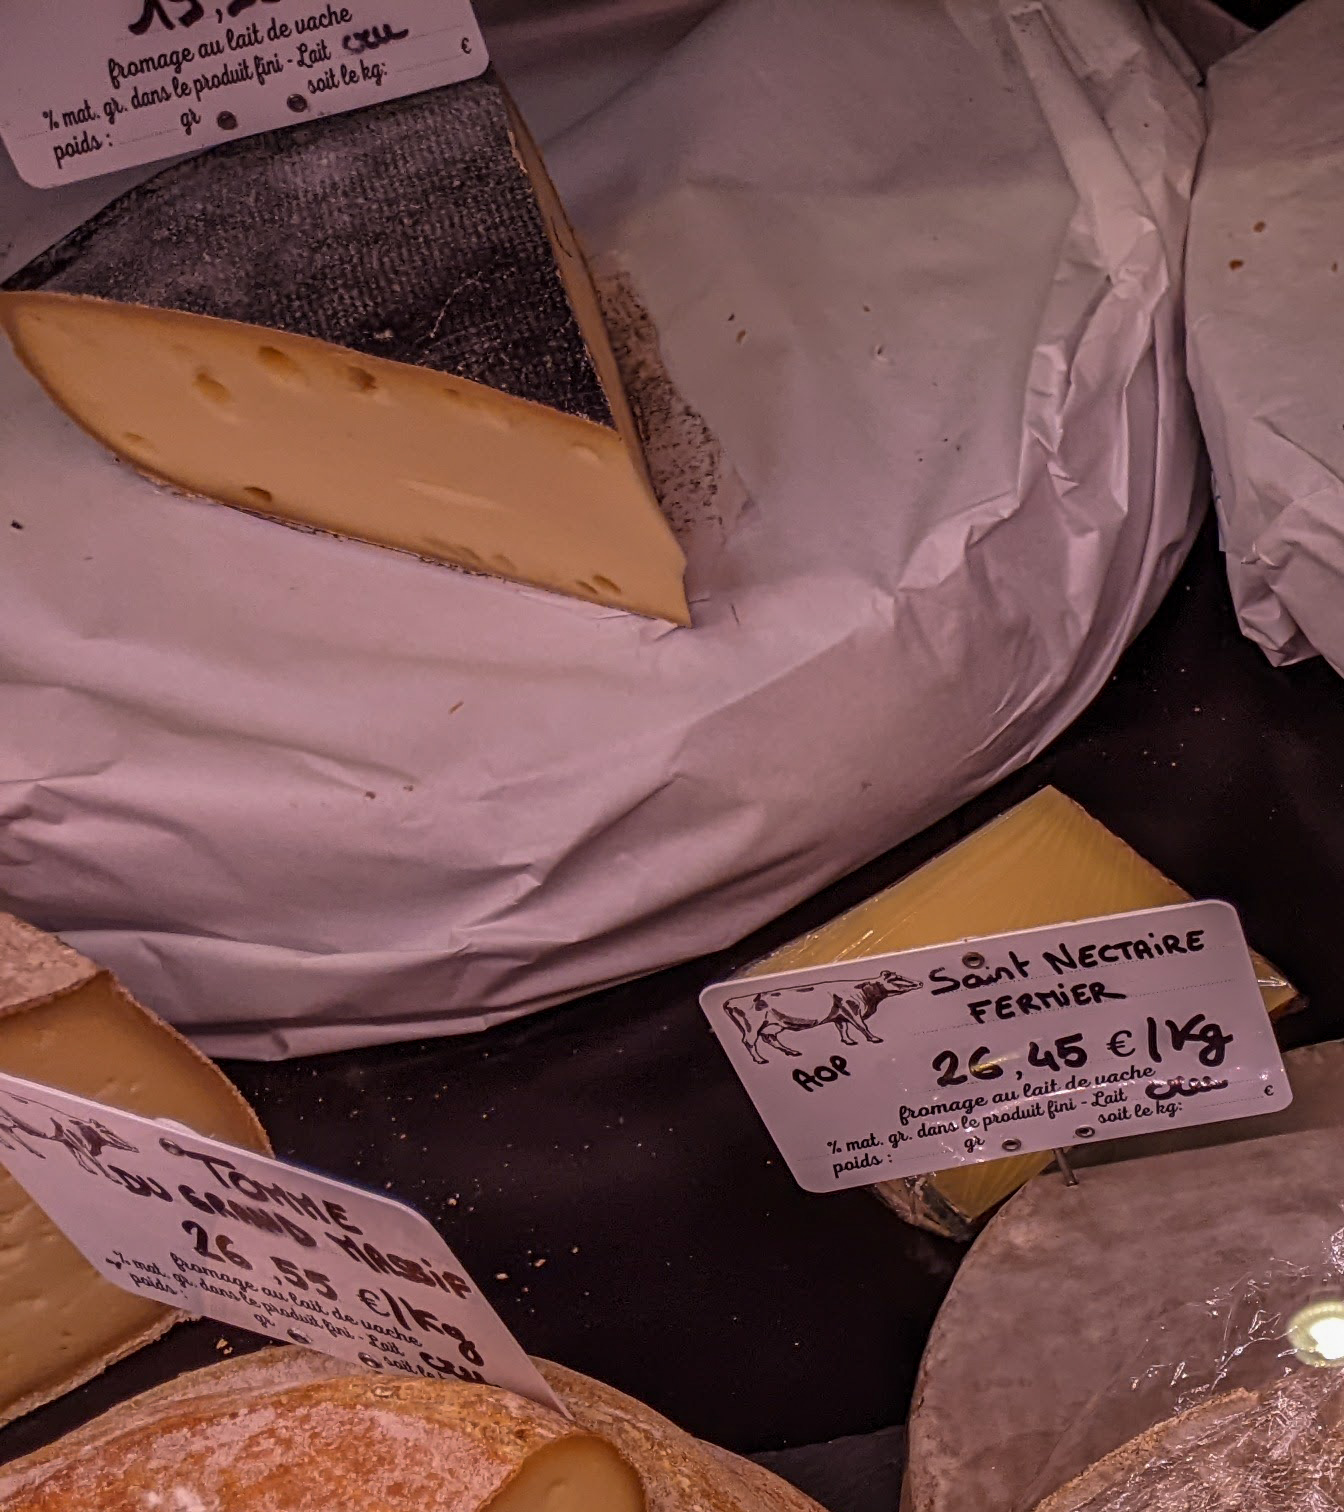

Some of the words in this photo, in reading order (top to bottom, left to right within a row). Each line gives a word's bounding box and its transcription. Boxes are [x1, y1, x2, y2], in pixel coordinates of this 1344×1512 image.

[109, 50, 195, 88] fromage
[198, 38, 224, 59] au
[227, 29, 264, 55] lait
[267, 19, 293, 41] de
[295, 4, 353, 36] vache
[62, 99, 101, 126] mat.
[103, 95, 128, 116] gr.
[131, 83, 171, 109] dans
[172, 76, 191, 98] le
[193, 60, 253, 101] produit
[255, 50, 284, 80] fini
[296, 40, 332, 68] Lait
[307, 72, 340, 95] soit
[340, 68, 361, 88] le
[54, 134, 102, 168] poids
[180, 110, 202, 135] gr
[928, 951, 1030, 996] Saint
[791, 1055, 853, 1093] AOP
[899, 1095, 988, 1126] fromage
[992, 1090, 1019, 1104] au
[1023, 1077, 1062, 1099] lait
[1065, 1072, 1092, 1090] de
[1095, 1064, 1156, 1086] vache
[833, 1156, 883, 1178] poids
[964, 1136, 985, 1153] gr
[1097, 1106, 1131, 1124] soit
[1135, 1101, 1153, 1116] le
[846, 1135, 884, 1154] mat.
[888, 1128, 913, 1148] gr.
[917, 1117, 959, 1137] dans
[961, 1115, 980, 1130] le
[982, 1102, 1045, 1130] produit
[1048, 1097, 1076, 1119] fini
[1091, 1088, 1128, 1107] Lait
[108, 1164, 174, 1202] DU
[183, 1150, 363, 1236] TOMME
[170, 1252, 258, 1293] fromage
[262, 1287, 289, 1303] au
[289, 1292, 328, 1316] lait
[332, 1305, 358, 1325] de
[361, 1317, 422, 1347] vache
[199, 1278, 240, 1301] dans
[240, 1291, 261, 1308] le
[261, 1301, 323, 1329] produit
[323, 1317, 354, 1339] fini
[367, 1334, 404, 1356] Lait
[254, 1313, 275, 1328] gr
[383, 1355, 417, 1374] soit
